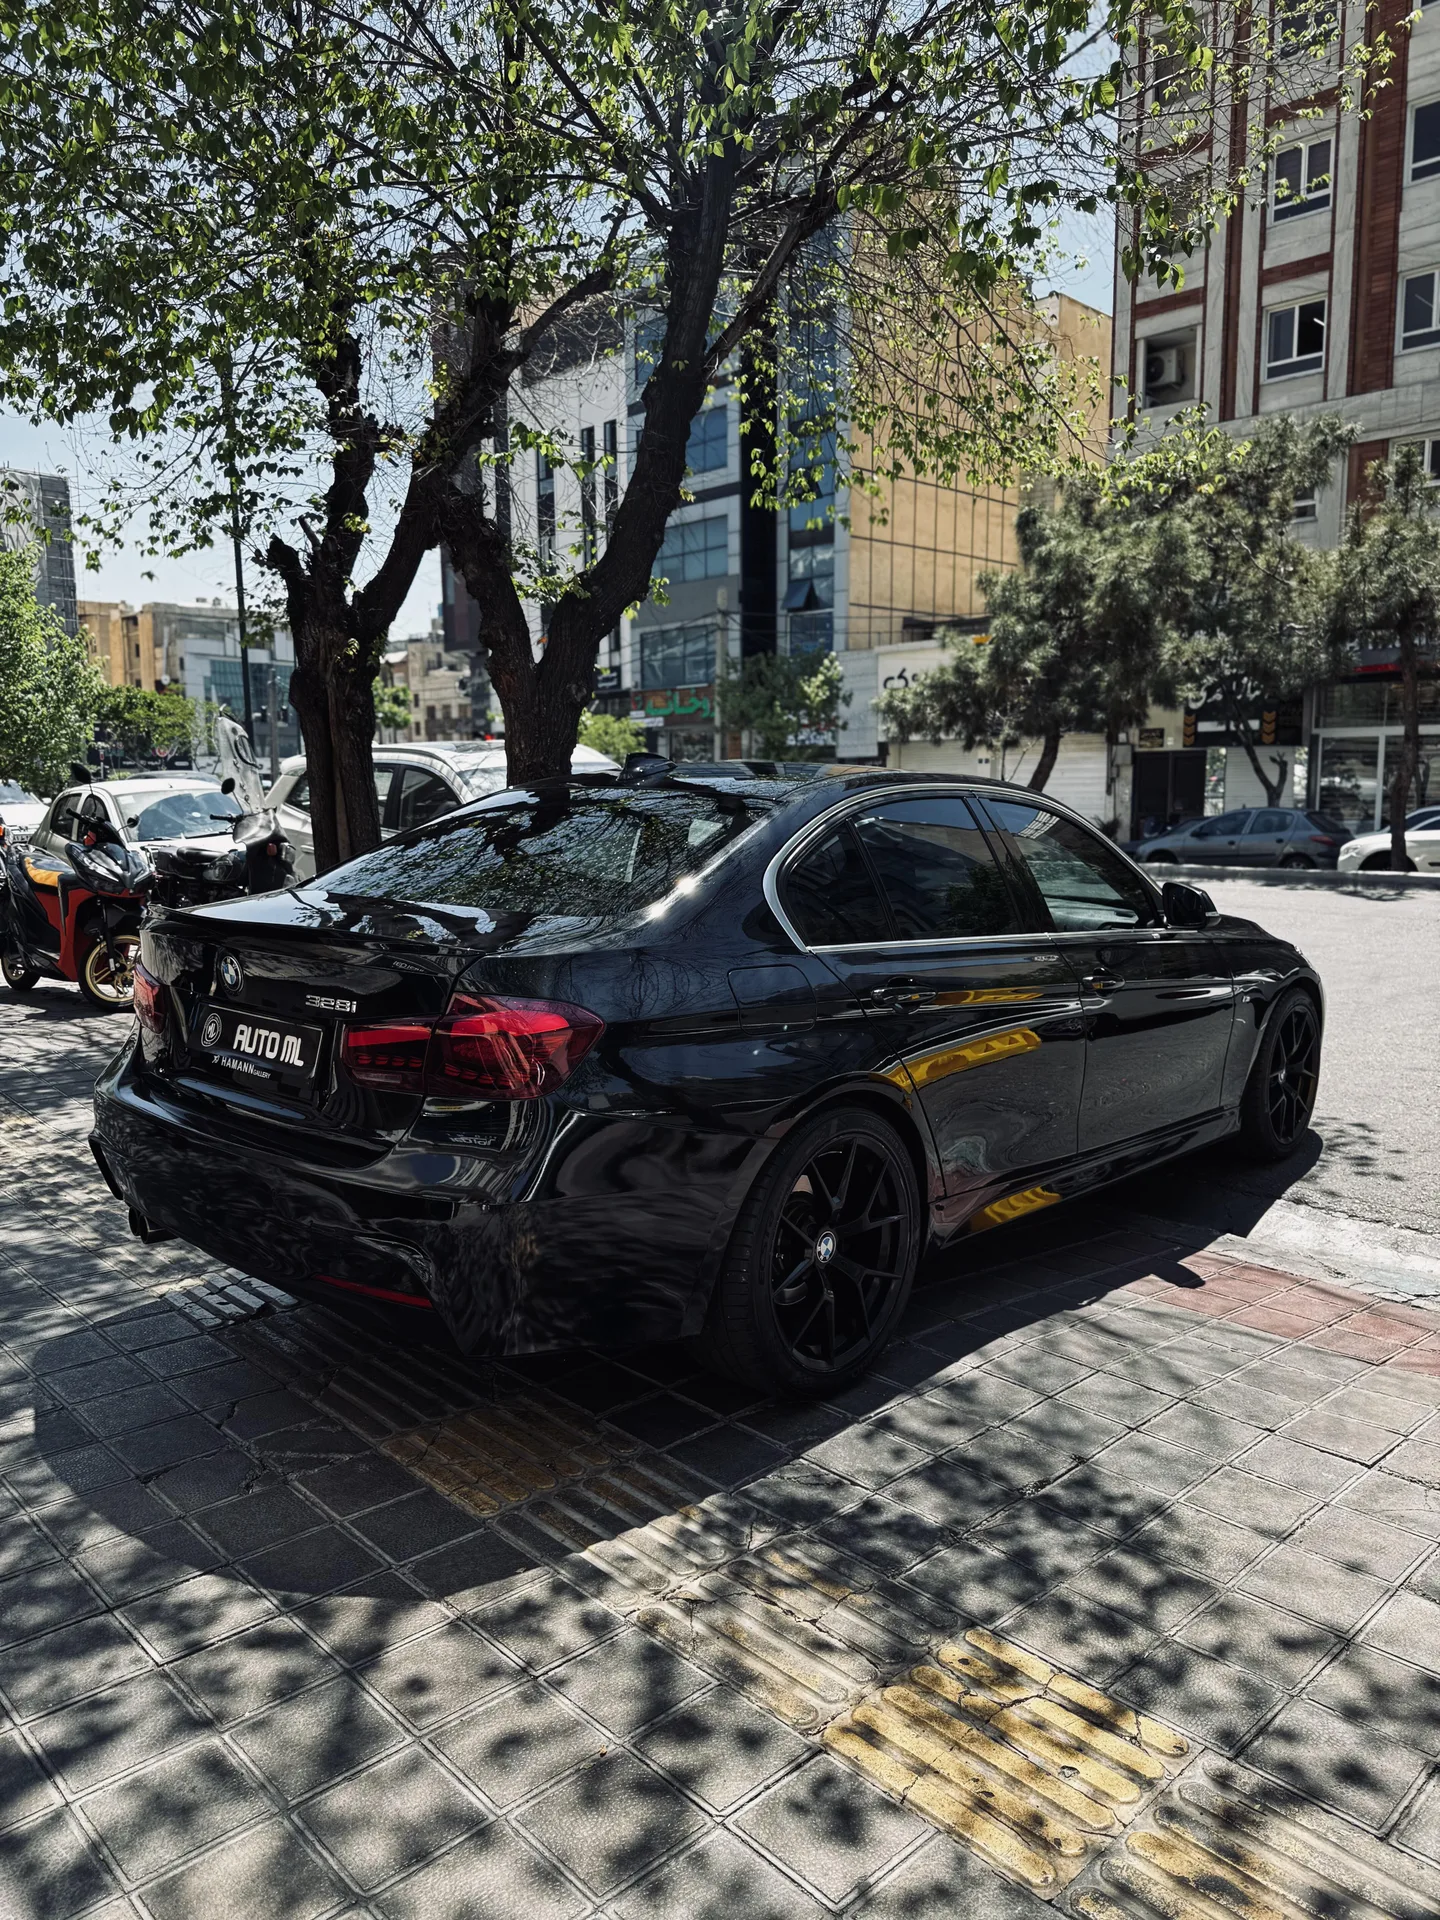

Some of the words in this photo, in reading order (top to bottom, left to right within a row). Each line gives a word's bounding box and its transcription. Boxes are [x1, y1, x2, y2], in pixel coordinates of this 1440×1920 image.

[305, 994, 357, 1013] 328i
[232, 1024, 280, 1059] AUTO
[280, 1035, 304, 1067] ML
[221, 1056, 254, 1075] HAMANN
[253, 1069, 271, 1080] GALLERY
